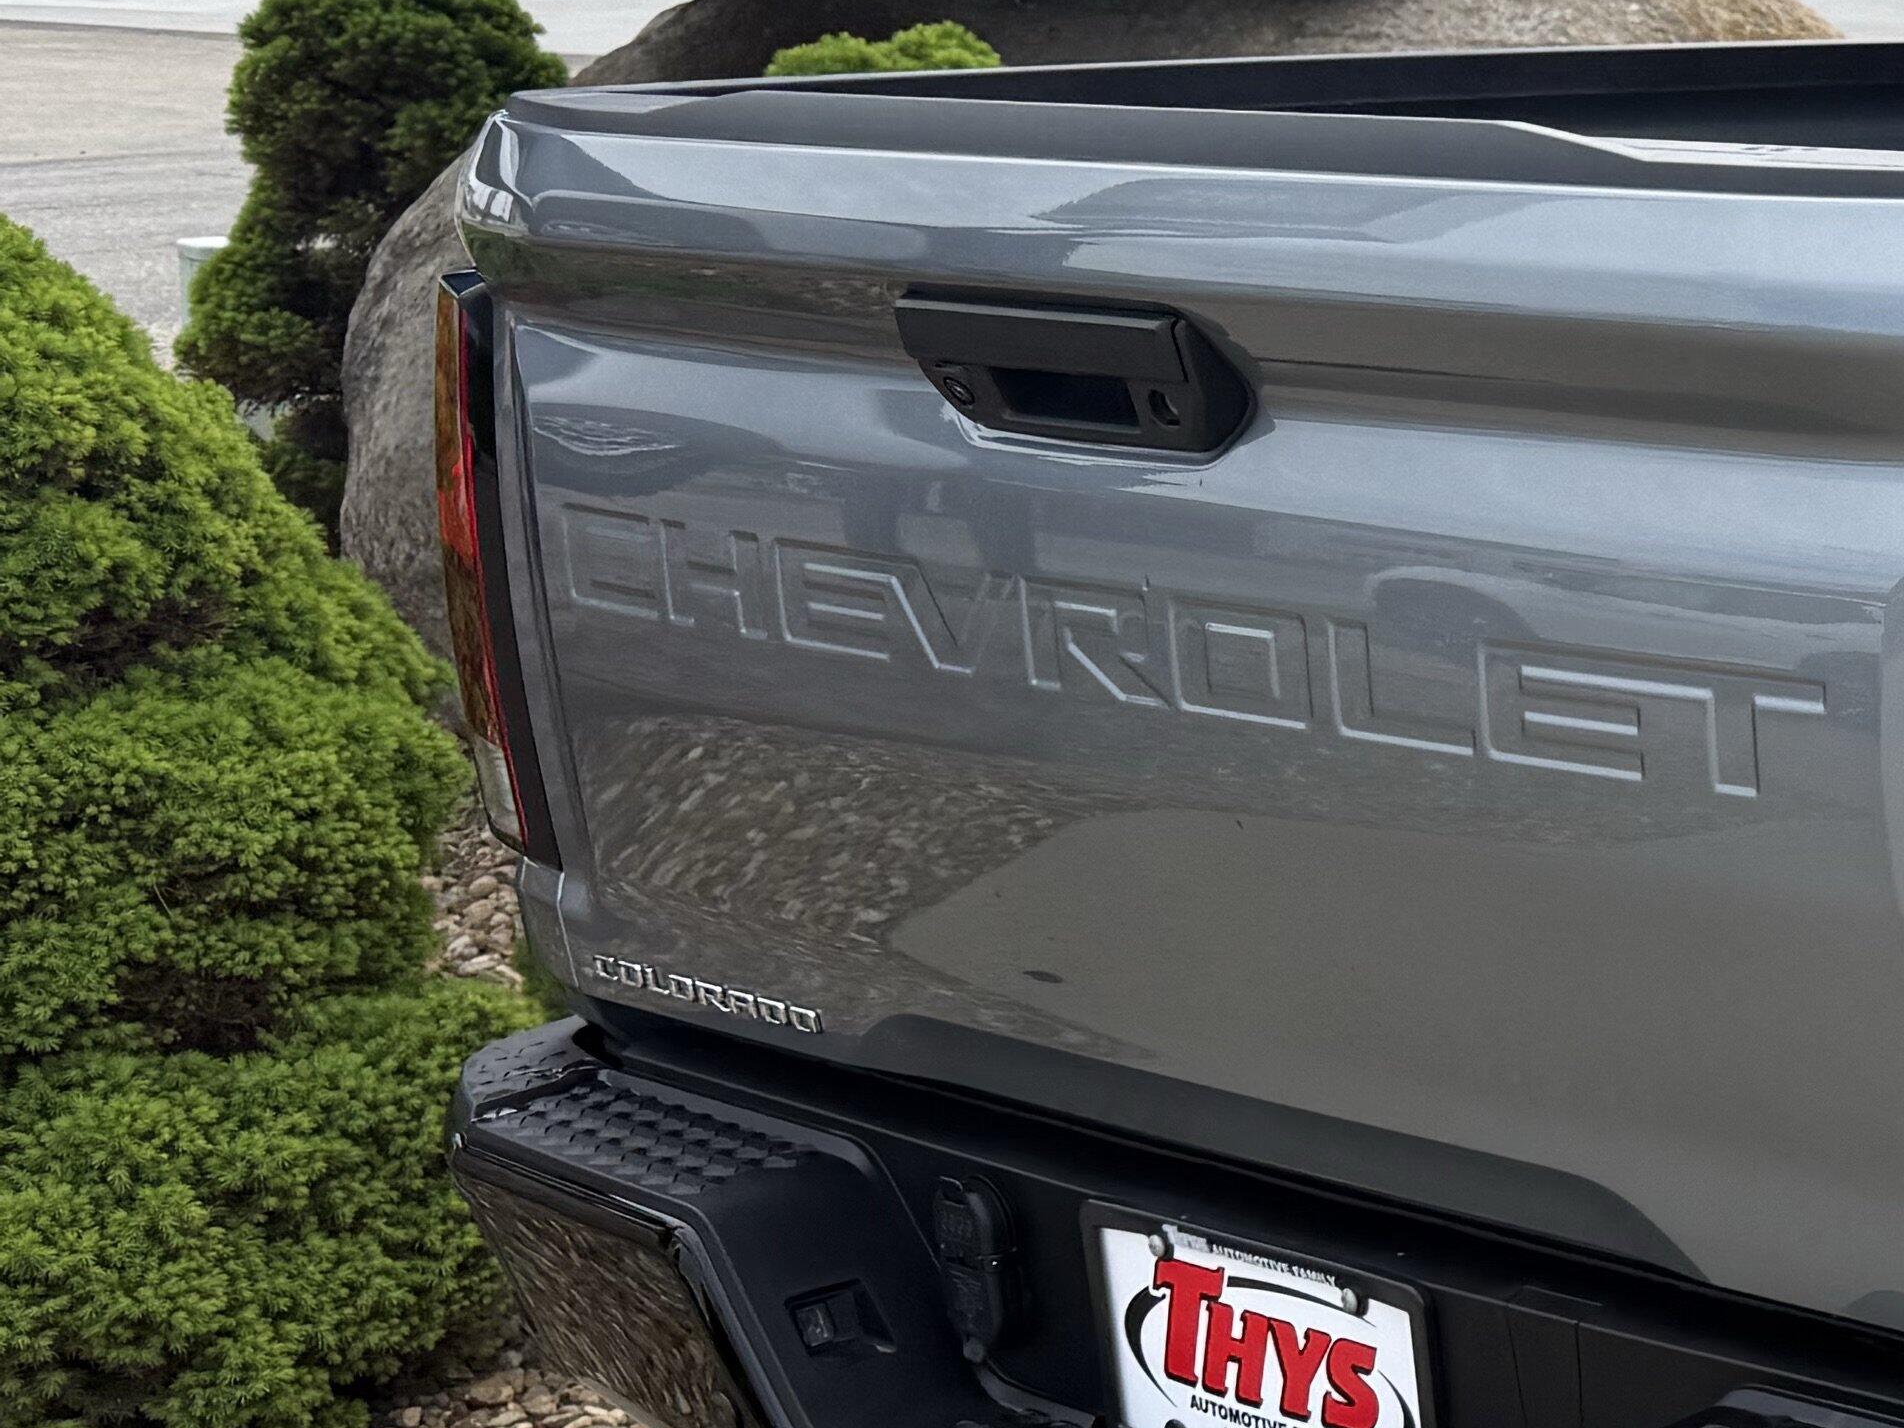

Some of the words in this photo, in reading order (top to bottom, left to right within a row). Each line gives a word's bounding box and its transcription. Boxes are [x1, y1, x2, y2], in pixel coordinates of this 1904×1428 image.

[561, 500, 1826, 799] CHEVROLET
[593, 954, 824, 1034] COLORADO
[1210, 1243, 1291, 1276] AUTOMOTIVE
[1291, 1264, 1337, 1288] FAMILY
